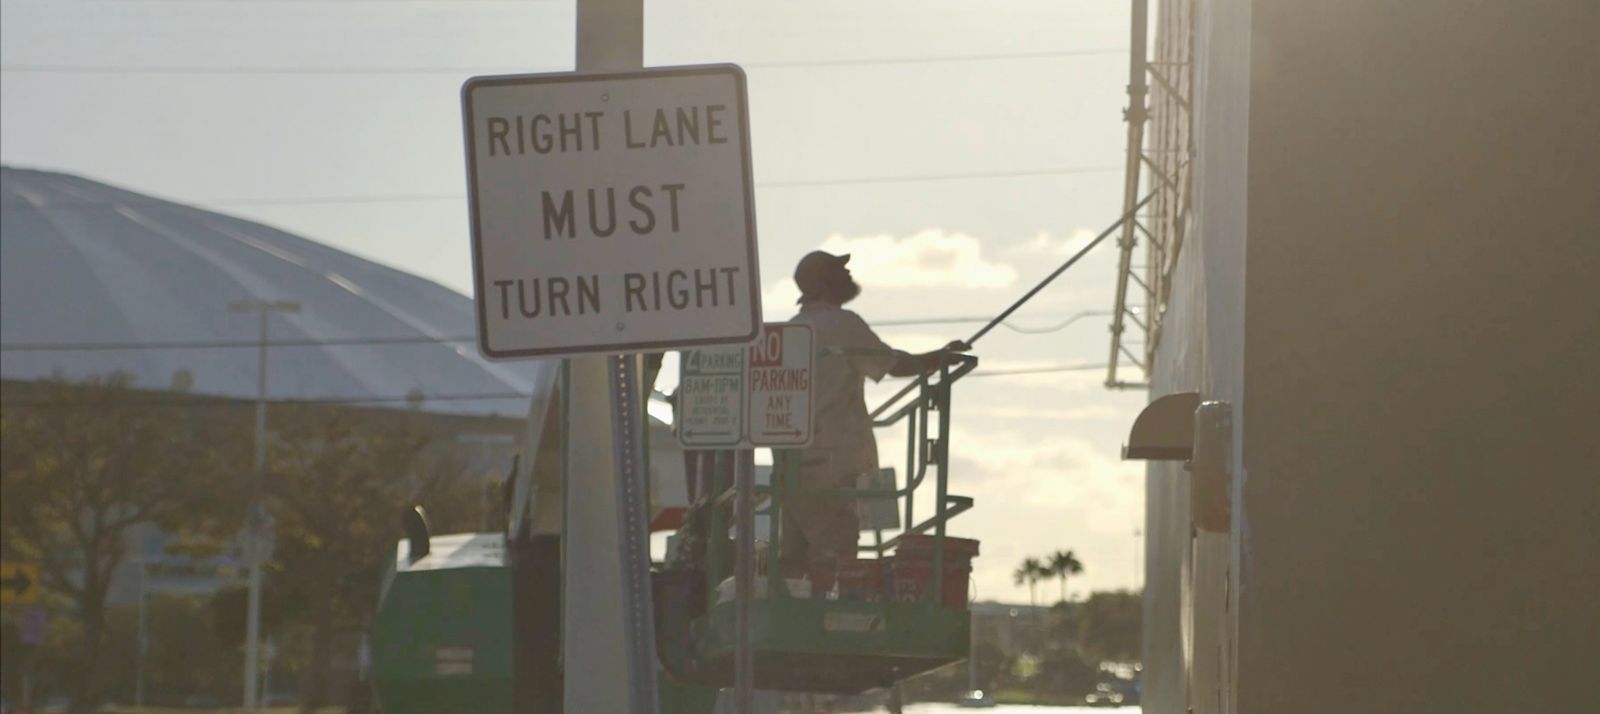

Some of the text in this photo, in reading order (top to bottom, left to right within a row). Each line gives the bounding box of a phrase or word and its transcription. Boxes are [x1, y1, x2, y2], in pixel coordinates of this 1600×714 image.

[487, 104, 728, 157] RIGHT LANE
[541, 183, 685, 241] MUST
[493, 266, 740, 319] TURN RIGHT
[751, 332, 780, 362] NO
[701, 353, 740, 369] PARKING
[752, 368, 808, 392] PARKING
[767, 395, 792, 411] ANY
[765, 413, 792, 429] TIME
